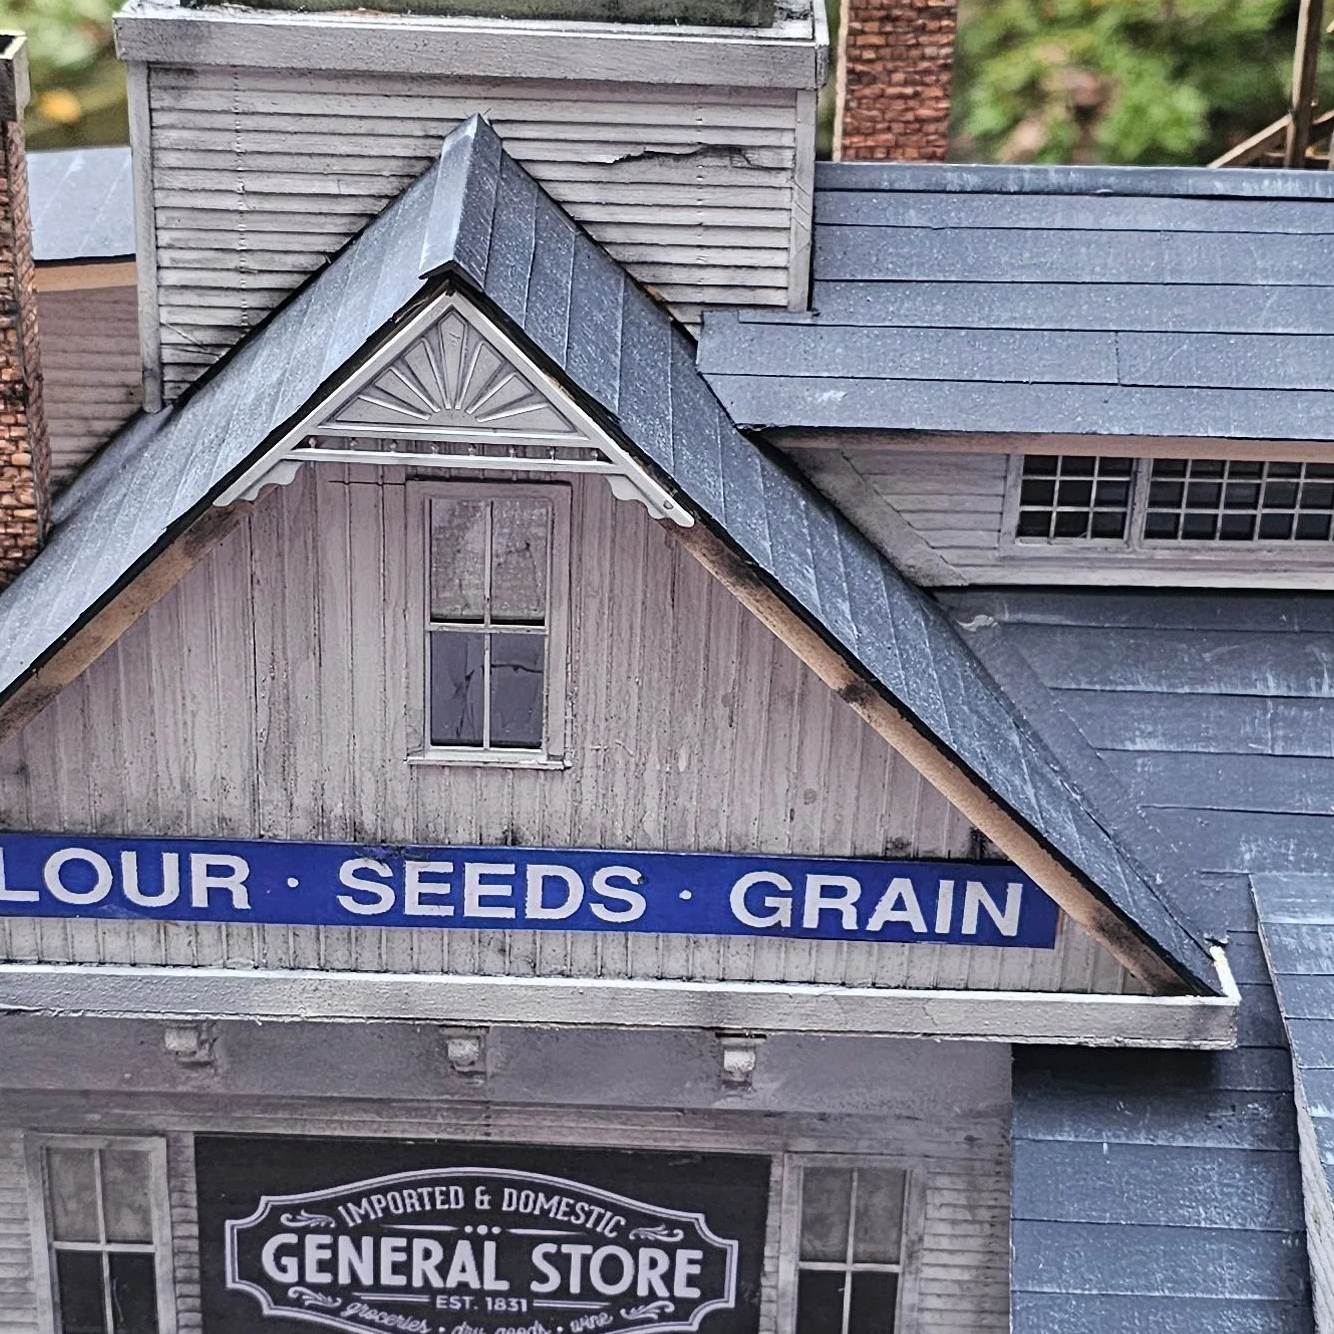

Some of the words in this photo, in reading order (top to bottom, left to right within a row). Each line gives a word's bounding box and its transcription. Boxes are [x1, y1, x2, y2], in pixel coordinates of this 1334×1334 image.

[337, 857, 647, 921] SEEDS
[729, 870, 1025, 936] GRAIN
[338, 1186, 466, 1228] IMPORTED
[474, 1187, 491, 1208] &
[502, 1189, 627, 1238] DOMESTIC
[261, 1234, 510, 1291] GENERAL
[530, 1243, 704, 1298] STORE
[341, 1301, 432, 1334] groceries
[570, 1312, 614, 1333] wine
[435, 1295, 479, 1311] EST.
[485, 1297, 528, 1313] 1831
